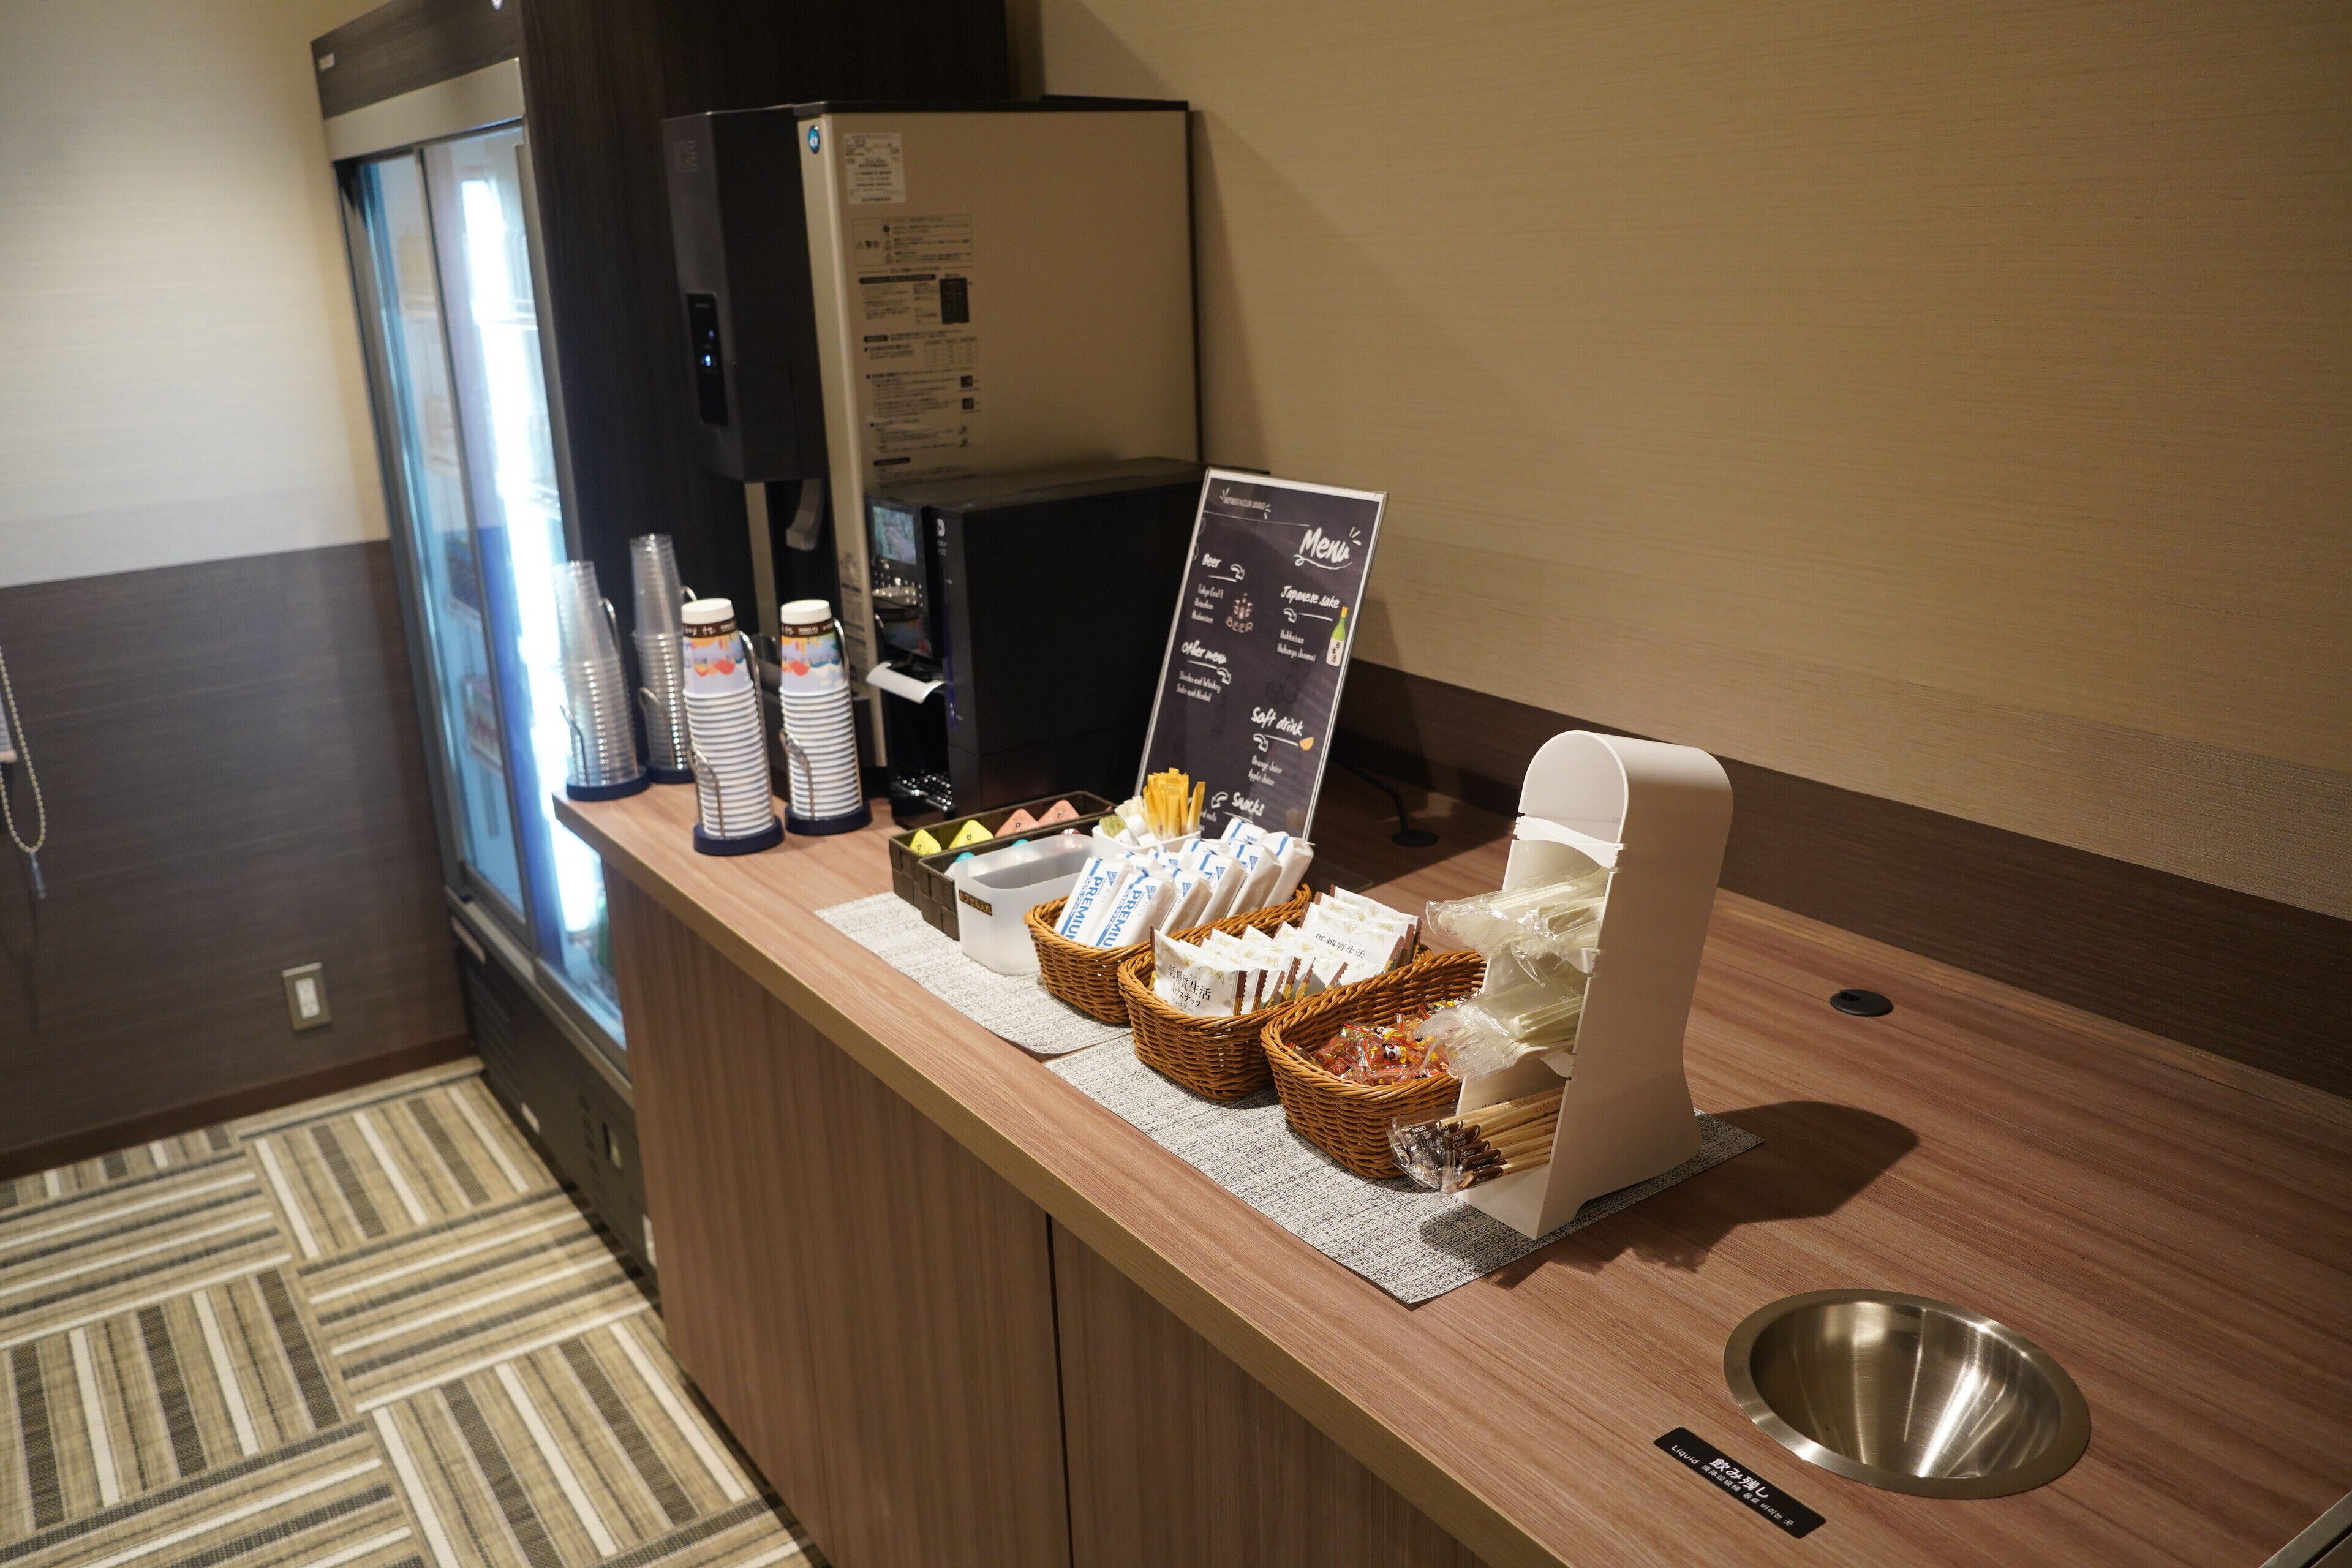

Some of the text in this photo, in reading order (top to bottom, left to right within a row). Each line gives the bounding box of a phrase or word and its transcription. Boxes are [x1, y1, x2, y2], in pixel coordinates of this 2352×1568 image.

[1299, 527, 1350, 564] Menu
[1202, 553, 1222, 568] Beer
[1280, 585, 1340, 608] Japanese sake
[1226, 616, 1253, 633] BEER
[1251, 707, 1303, 736] Soft drink
[1251, 755, 1269, 771] Orange
[1231, 791, 1265, 817] Snacks
[1169, 963, 1212, 1001] 低糖質生活
[1412, 1125, 1427, 1134] OPEN
[1452, 1133, 1466, 1142] OPEN
[1671, 1445, 1700, 1464] Liquid
[1760, 1502, 1783, 1520] 버리는
[1709, 1458, 1769, 1498] 飲み残し
